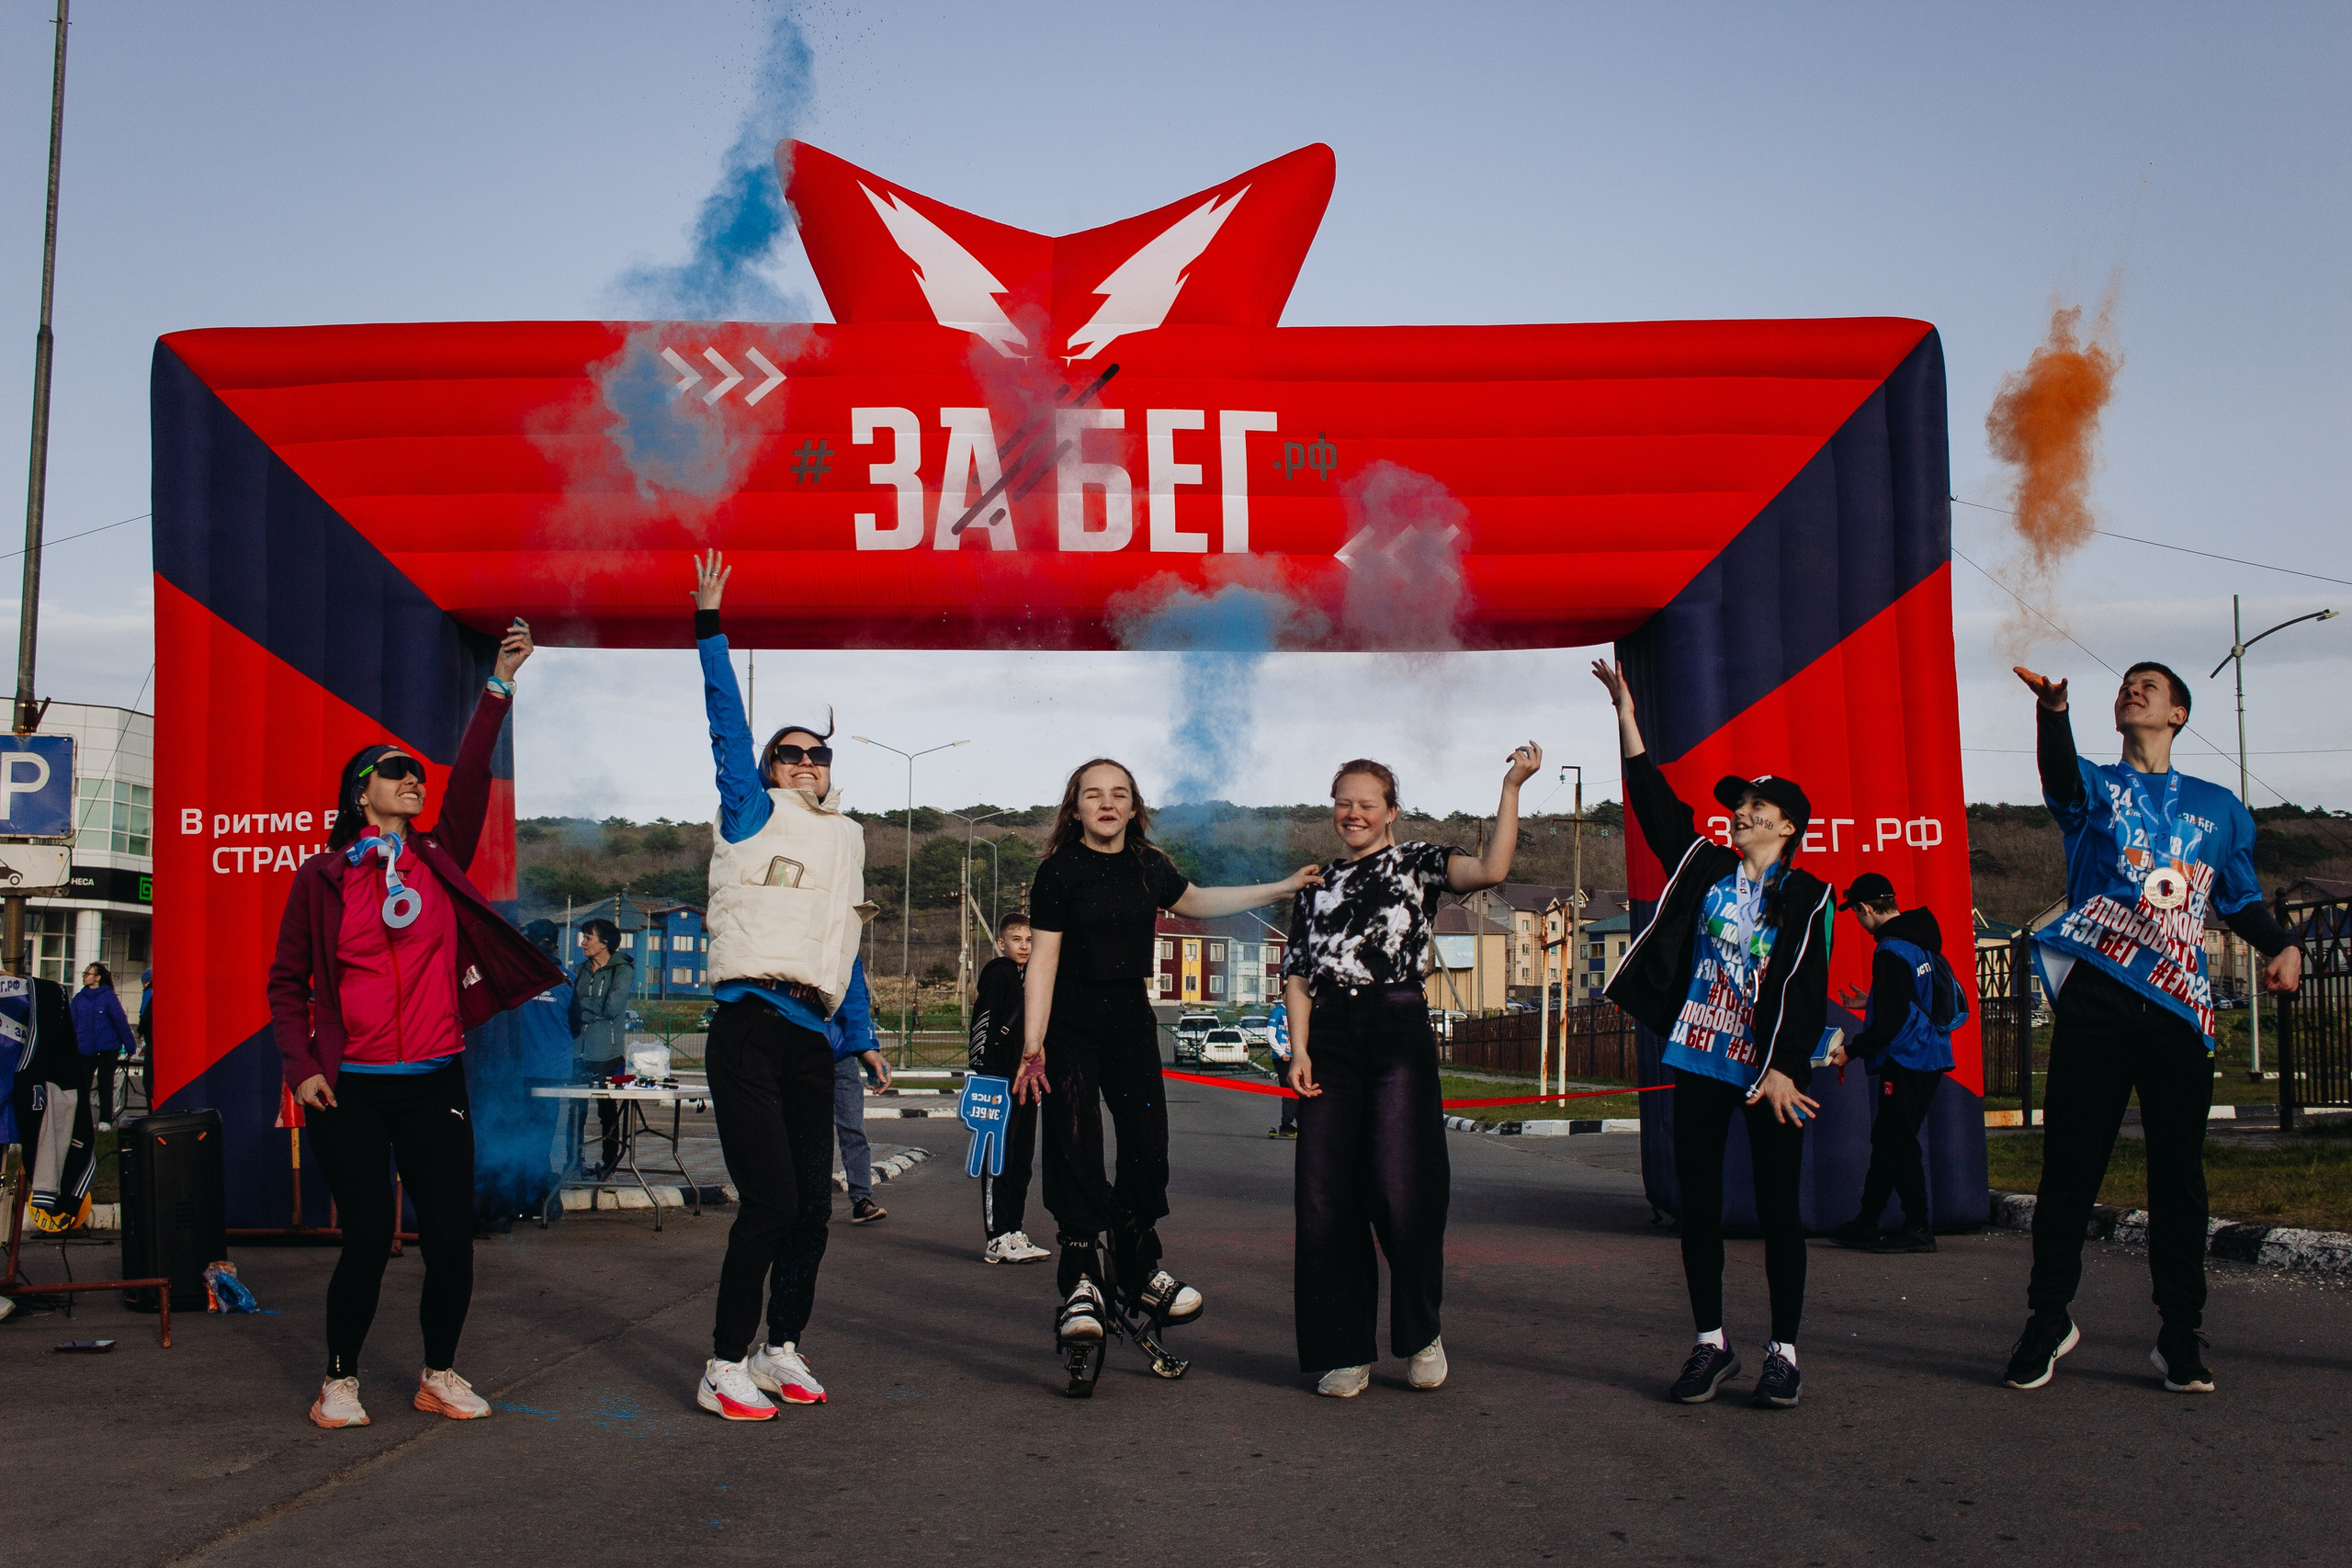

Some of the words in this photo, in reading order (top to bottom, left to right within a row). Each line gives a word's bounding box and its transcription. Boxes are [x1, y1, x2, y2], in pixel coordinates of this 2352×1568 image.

[0, 752, 51, 820] P
[181, 807, 203, 835] В
[213, 810, 313, 839] ритме
[1707, 815, 1942, 853] ЗЕГ.РФ
[212, 843, 336, 874] СТРАН
[2060, 912, 2142, 968] #ЗАБЕГ
